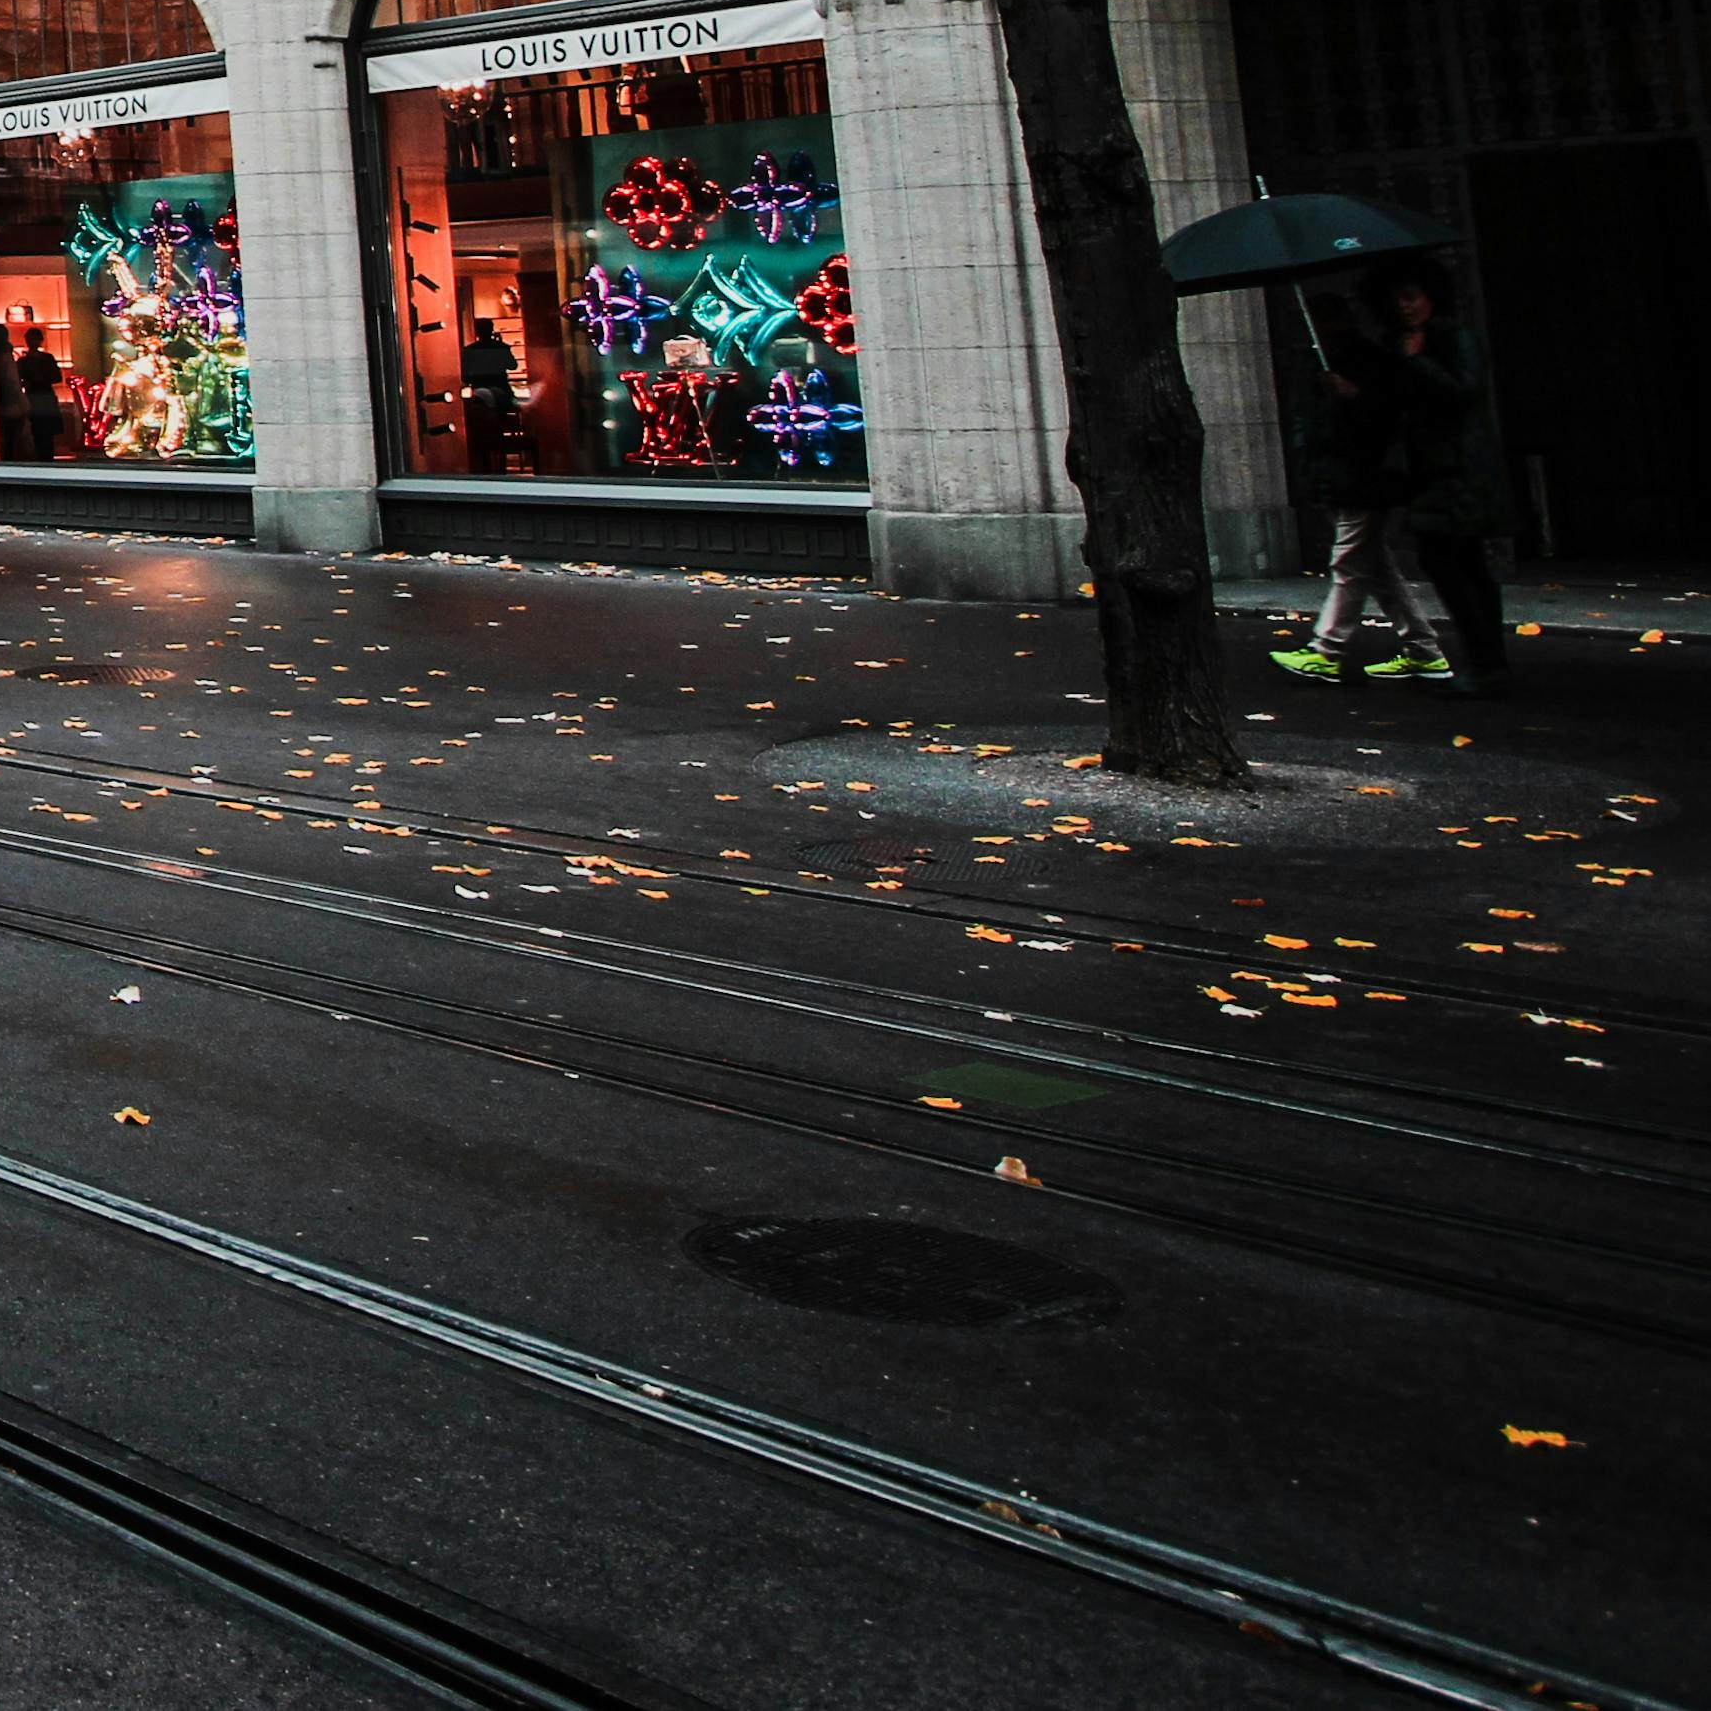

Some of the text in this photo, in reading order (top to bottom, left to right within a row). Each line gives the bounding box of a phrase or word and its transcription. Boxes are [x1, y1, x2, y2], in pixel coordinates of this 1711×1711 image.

[482, 18, 719, 71] LOUIS VUITTON
[59, 94, 148, 124] VUITTON
